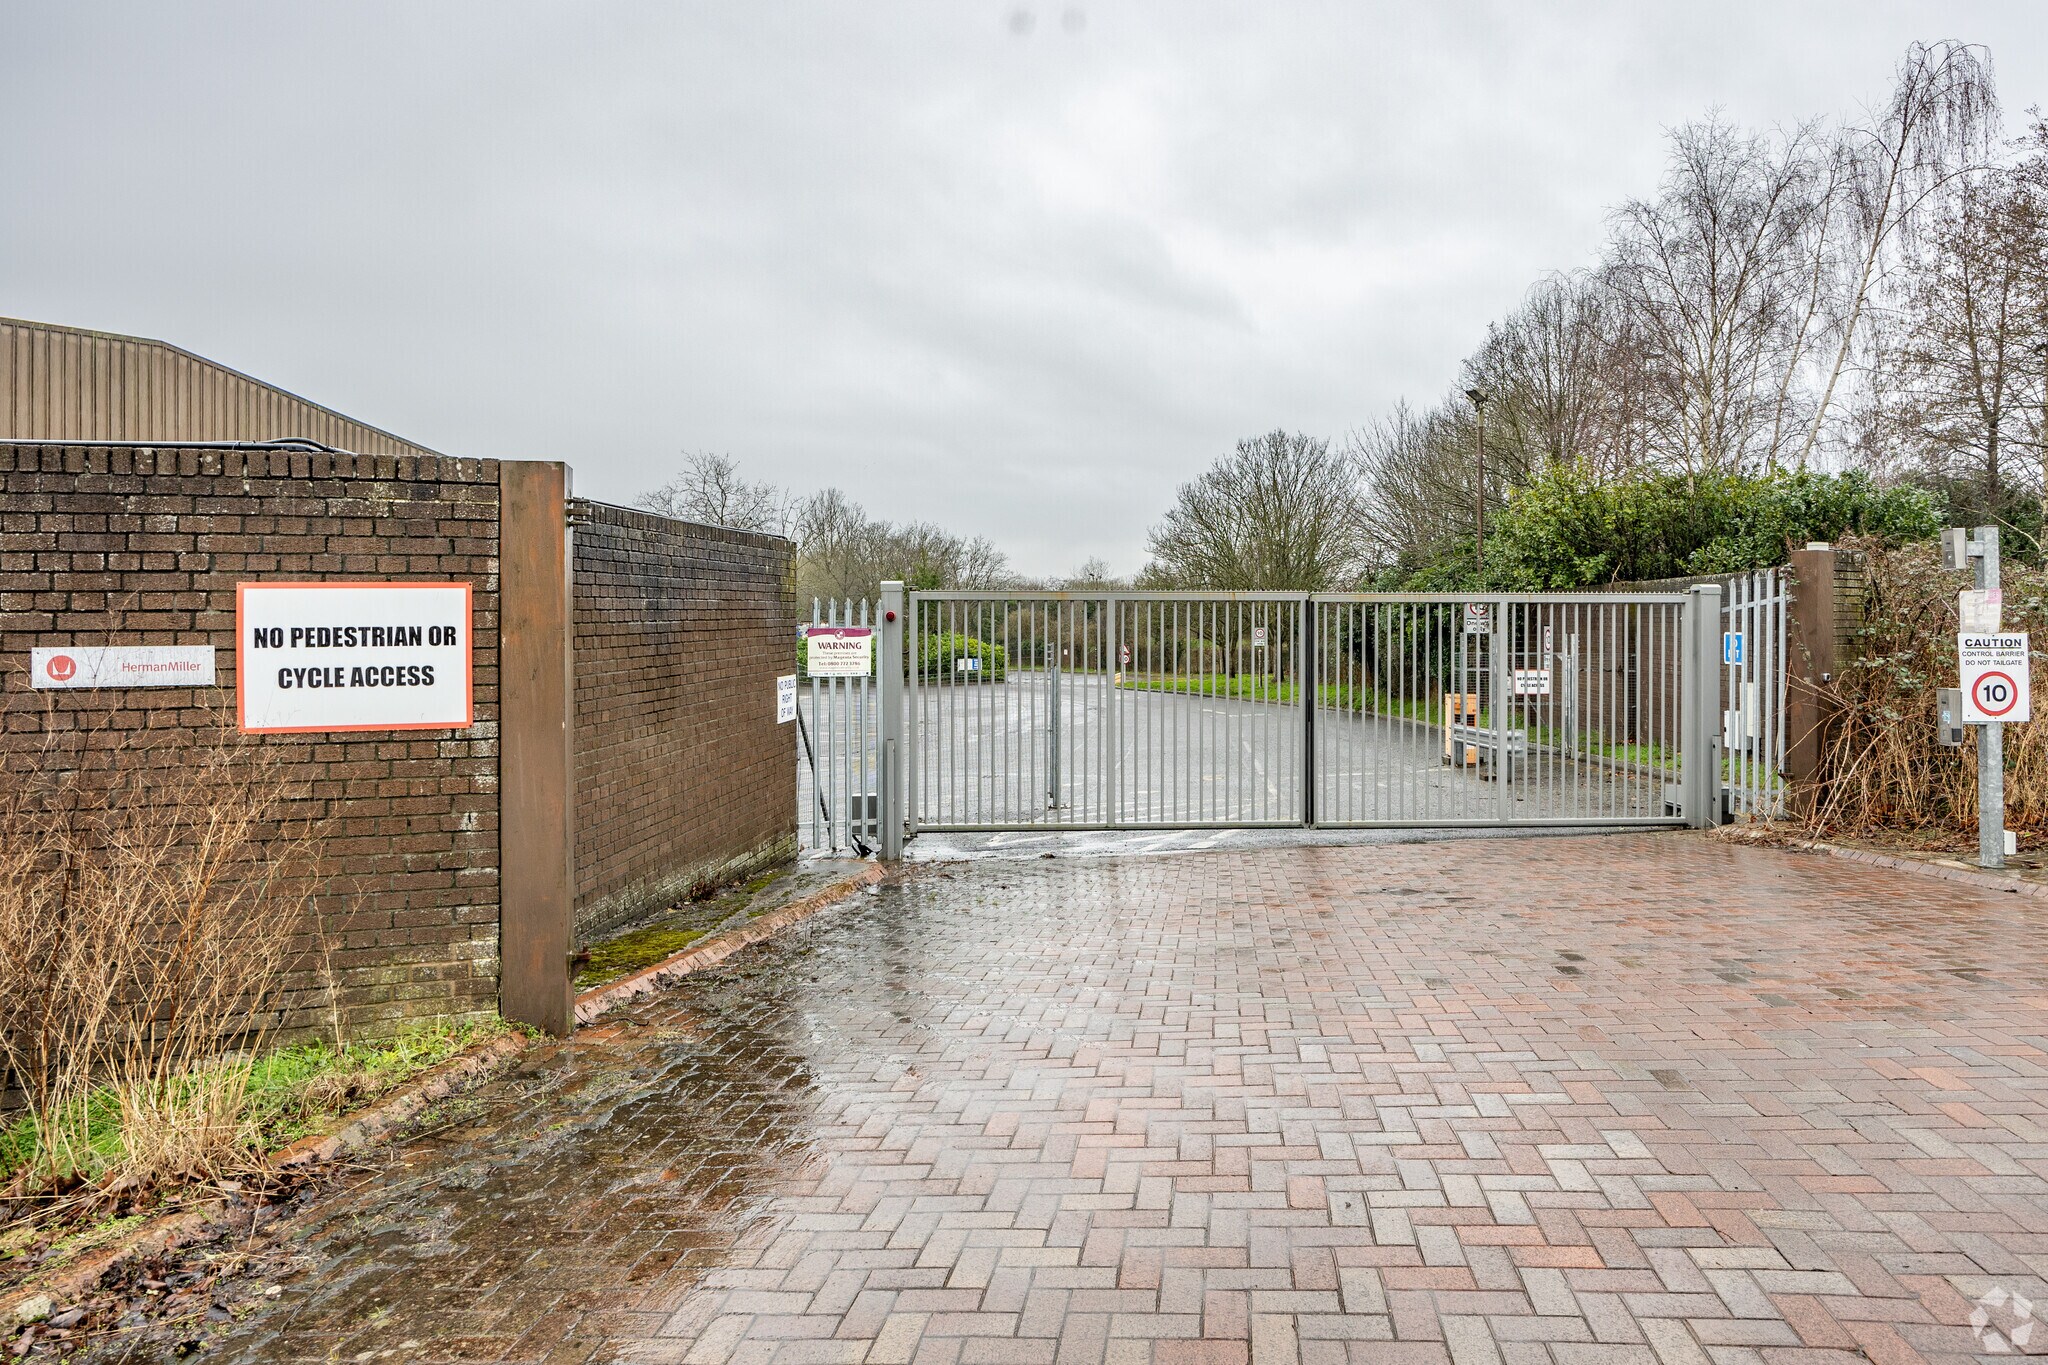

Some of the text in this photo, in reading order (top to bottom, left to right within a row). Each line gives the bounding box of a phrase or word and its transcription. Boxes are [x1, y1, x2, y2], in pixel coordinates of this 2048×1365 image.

[254, 625, 457, 649] NO PEDESTRIAN OR
[817, 642, 862, 650] WARNING
[1965, 639, 2021, 647] CAUTION
[122, 662, 202, 672] HermanMiller
[278, 665, 435, 690] CYCLE ACCESS
[784, 679, 796, 690] PUBLIC
[782, 693, 793, 704] RIGHT
[1983, 684, 2007, 702] 10
[781, 708, 786, 717] OF
